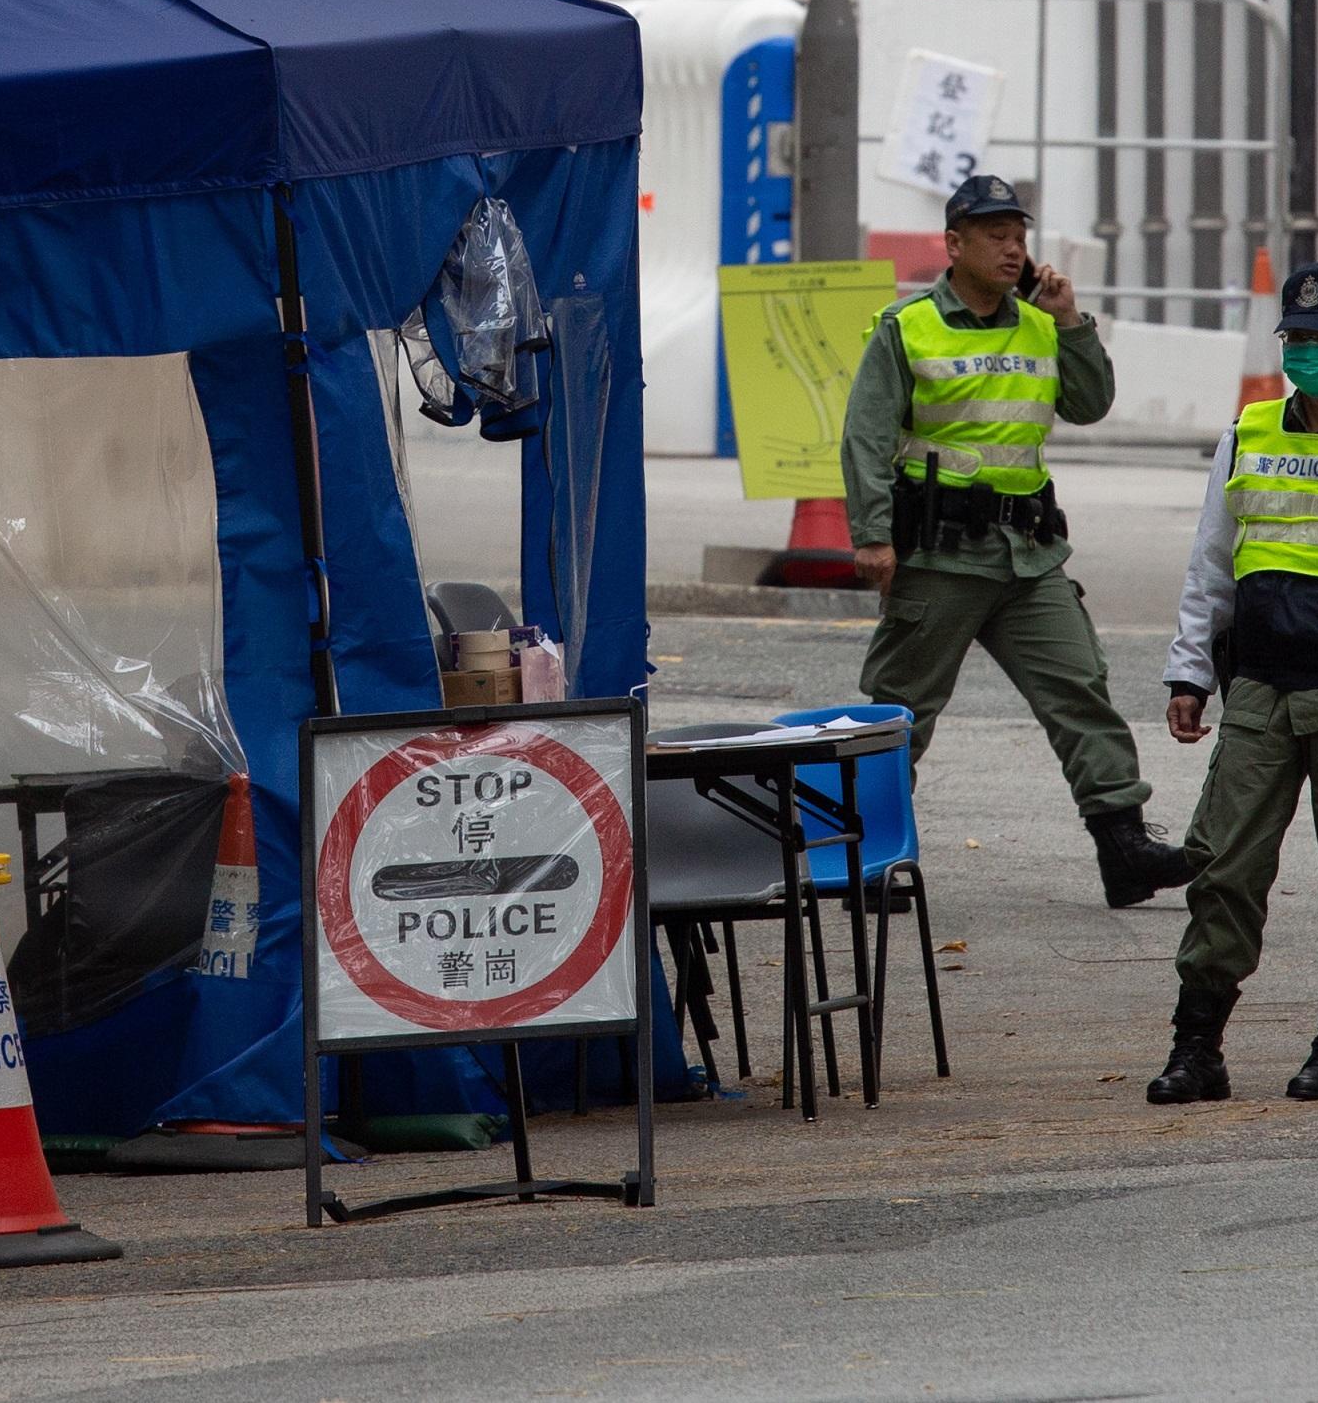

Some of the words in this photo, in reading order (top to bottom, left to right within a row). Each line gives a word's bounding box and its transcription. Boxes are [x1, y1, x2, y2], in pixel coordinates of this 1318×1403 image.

[948, 151, 978, 191] 3
[1256, 456, 1274, 474] 警
[415, 770, 533, 808] STOP
[451, 810, 495, 854] 停
[398, 902, 558, 944] POLICE
[437, 947, 517, 990] 警崗
